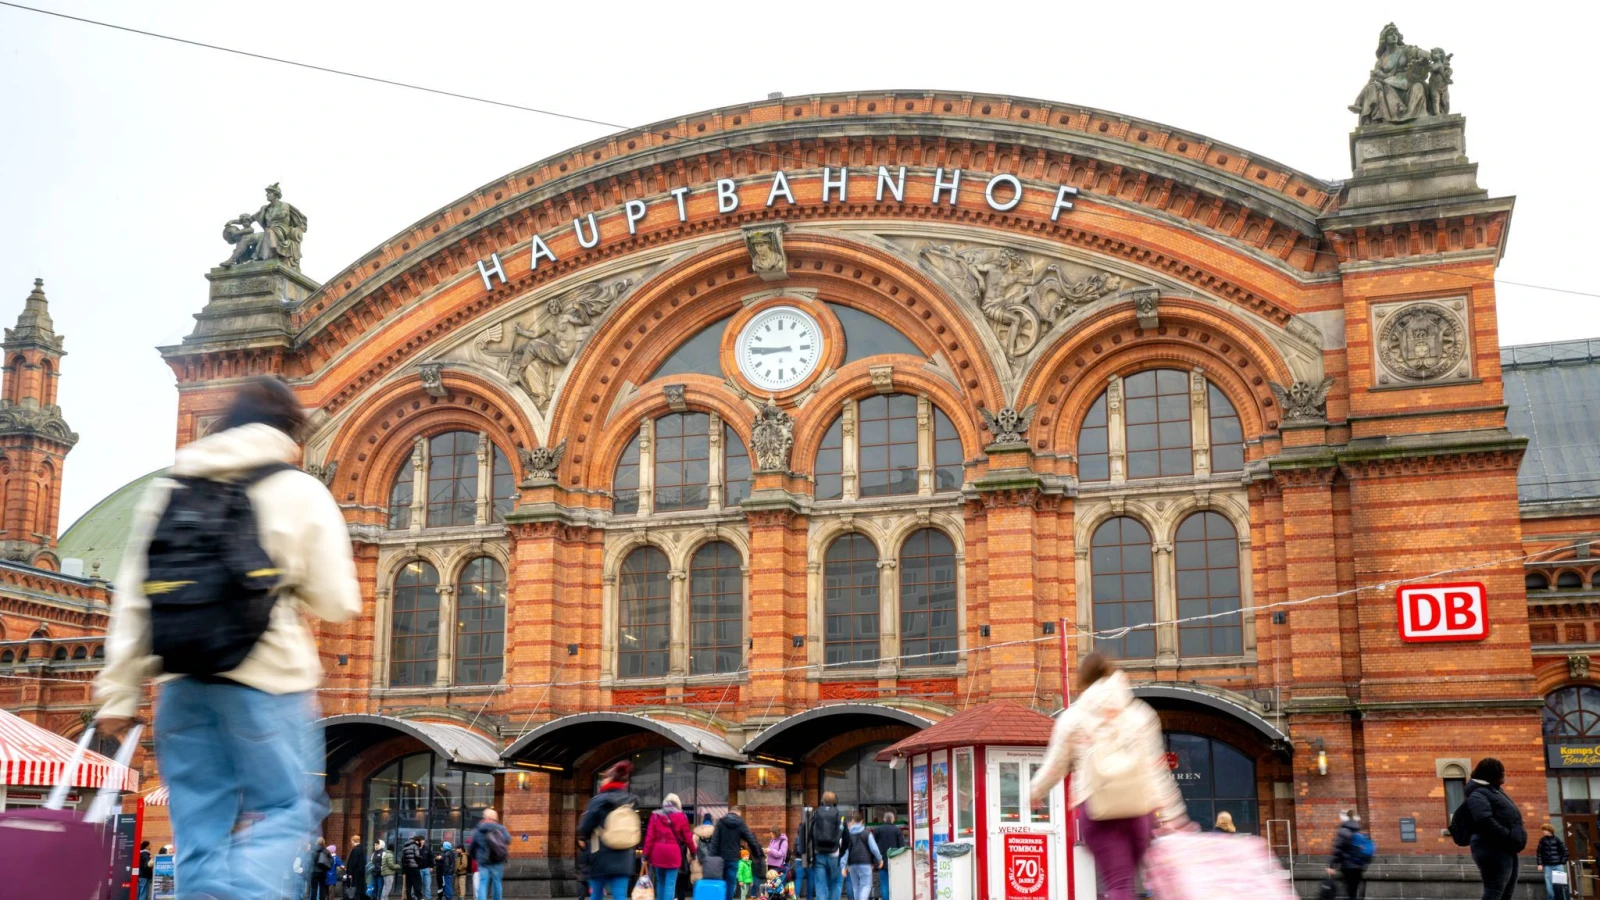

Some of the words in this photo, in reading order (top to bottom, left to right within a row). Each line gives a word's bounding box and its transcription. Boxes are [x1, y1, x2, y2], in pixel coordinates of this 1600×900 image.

[477, 165, 1078, 292] HAUPTBAHNHOF
[1408, 592, 1477, 632] DB
[1560, 746, 1593, 756] Kamps
[939, 861, 951, 870] LOS
[1015, 859, 1038, 877] 70
